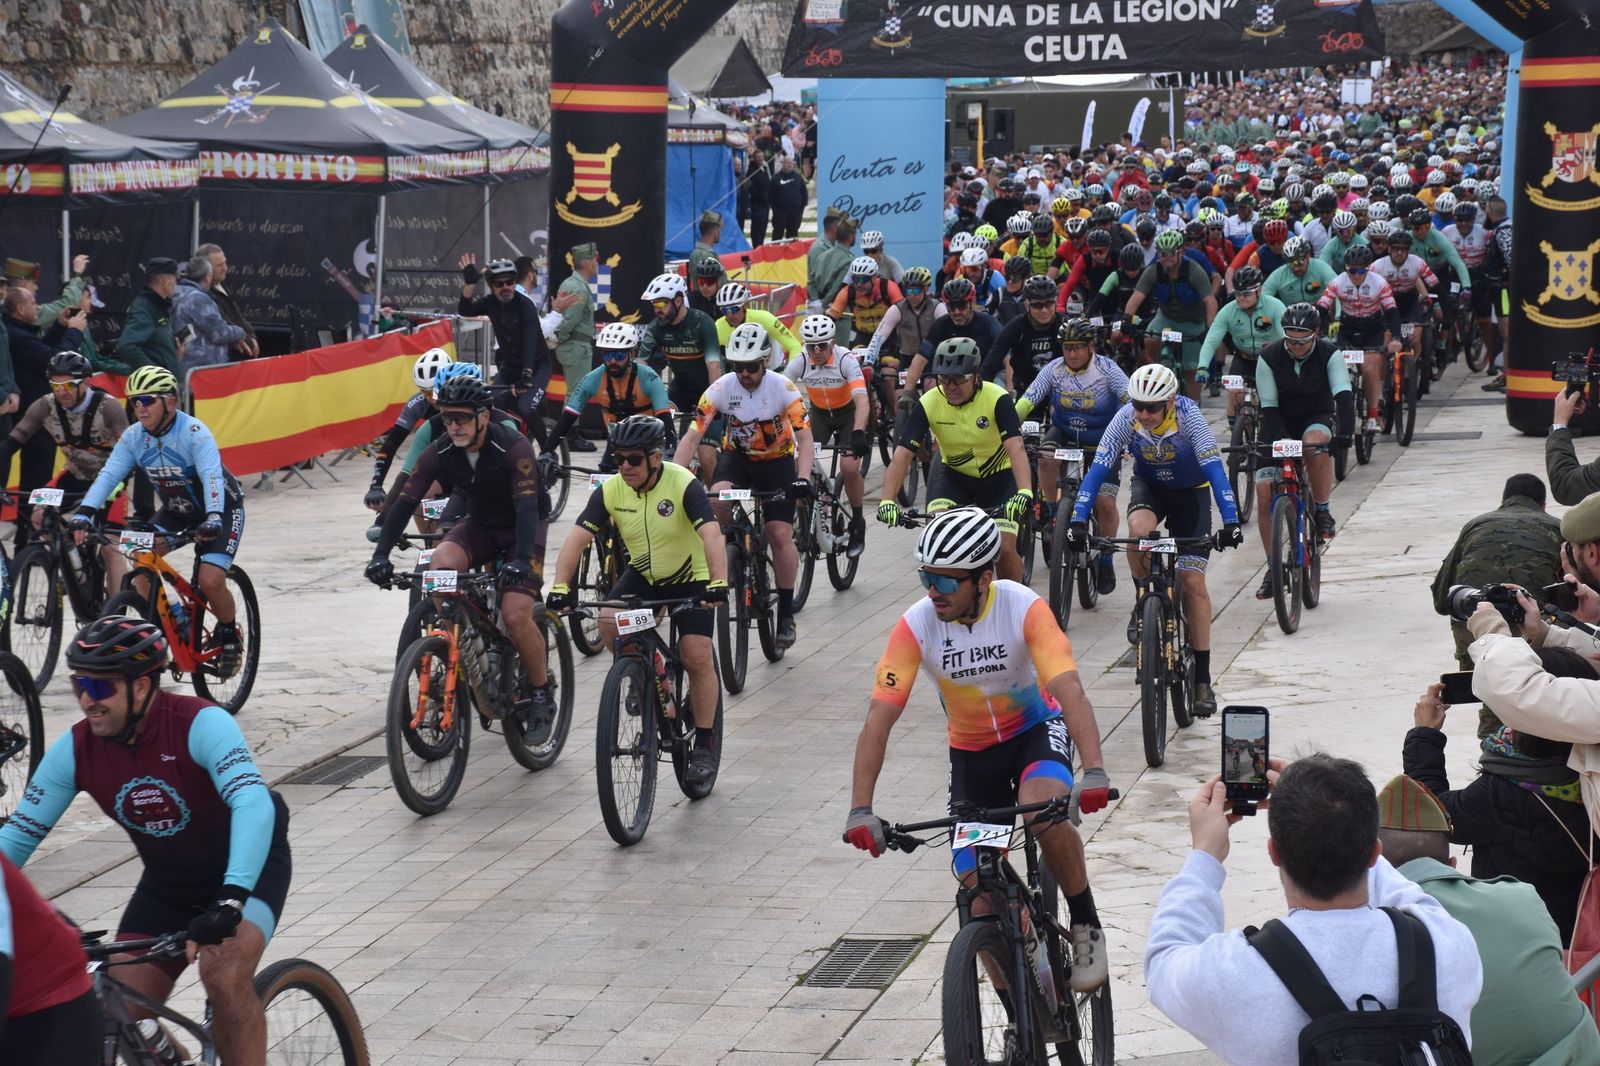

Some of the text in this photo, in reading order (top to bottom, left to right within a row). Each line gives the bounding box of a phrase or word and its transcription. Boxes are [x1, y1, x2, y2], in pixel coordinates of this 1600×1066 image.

[1026, 4, 1060, 26] DE
[1070, 2, 1104, 25] LA
[1023, 33, 1128, 63] CEUTA
[198, 150, 357, 182] EPORTIVO
[829, 154, 927, 184] Ceuta es
[145, 466, 185, 478] CBR
[436, 577, 455, 587] 327
[634, 615, 648, 626] 89
[942, 643, 1009, 671] FIT BIKE
[885, 671, 897, 687] 5
[145, 818, 176, 831] BTT
